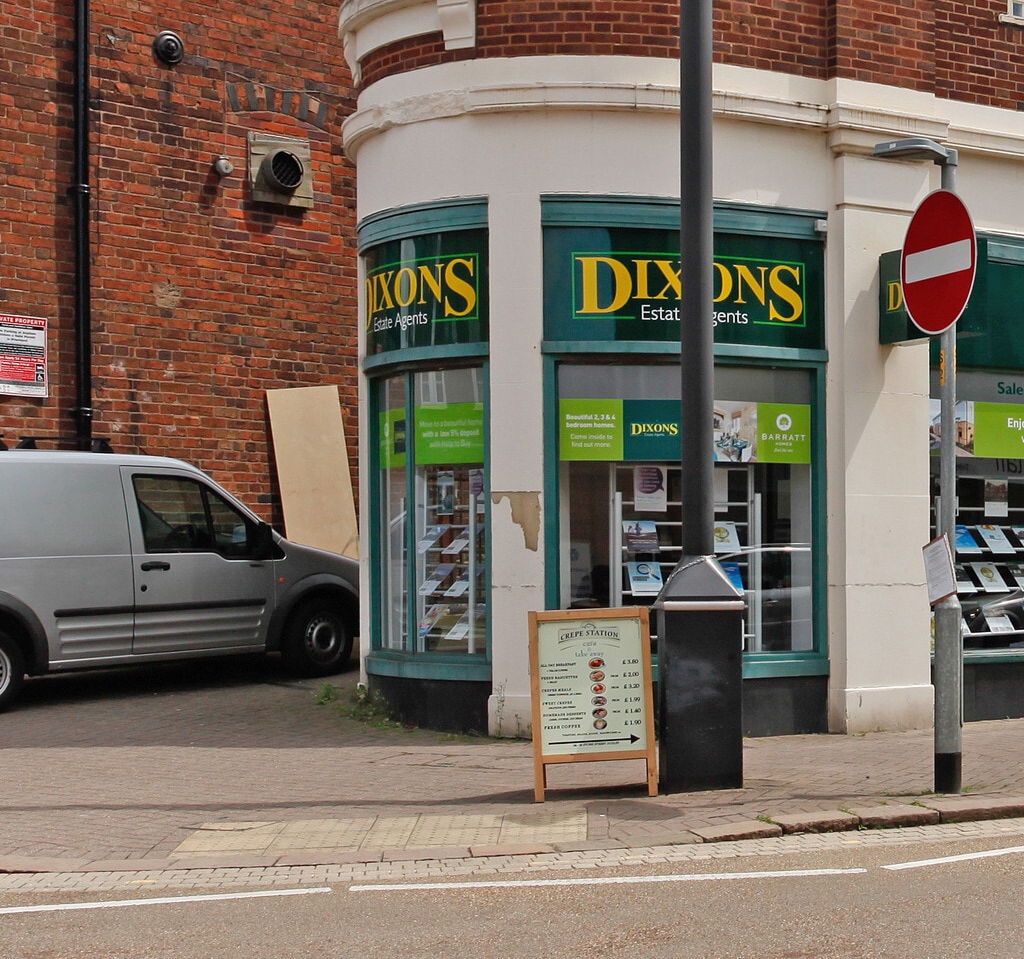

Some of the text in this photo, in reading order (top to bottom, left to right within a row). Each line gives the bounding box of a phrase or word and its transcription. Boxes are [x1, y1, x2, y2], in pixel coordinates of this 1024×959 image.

[15, 317, 45, 326] PROPERTY
[374, 311, 428, 332] Estate Agents
[641, 304, 749, 327] Estat gents
[631, 423, 678, 436] DIXONS
[761, 433, 806, 441] BARRATT
[560, 629, 619, 641] CREPE STATION
